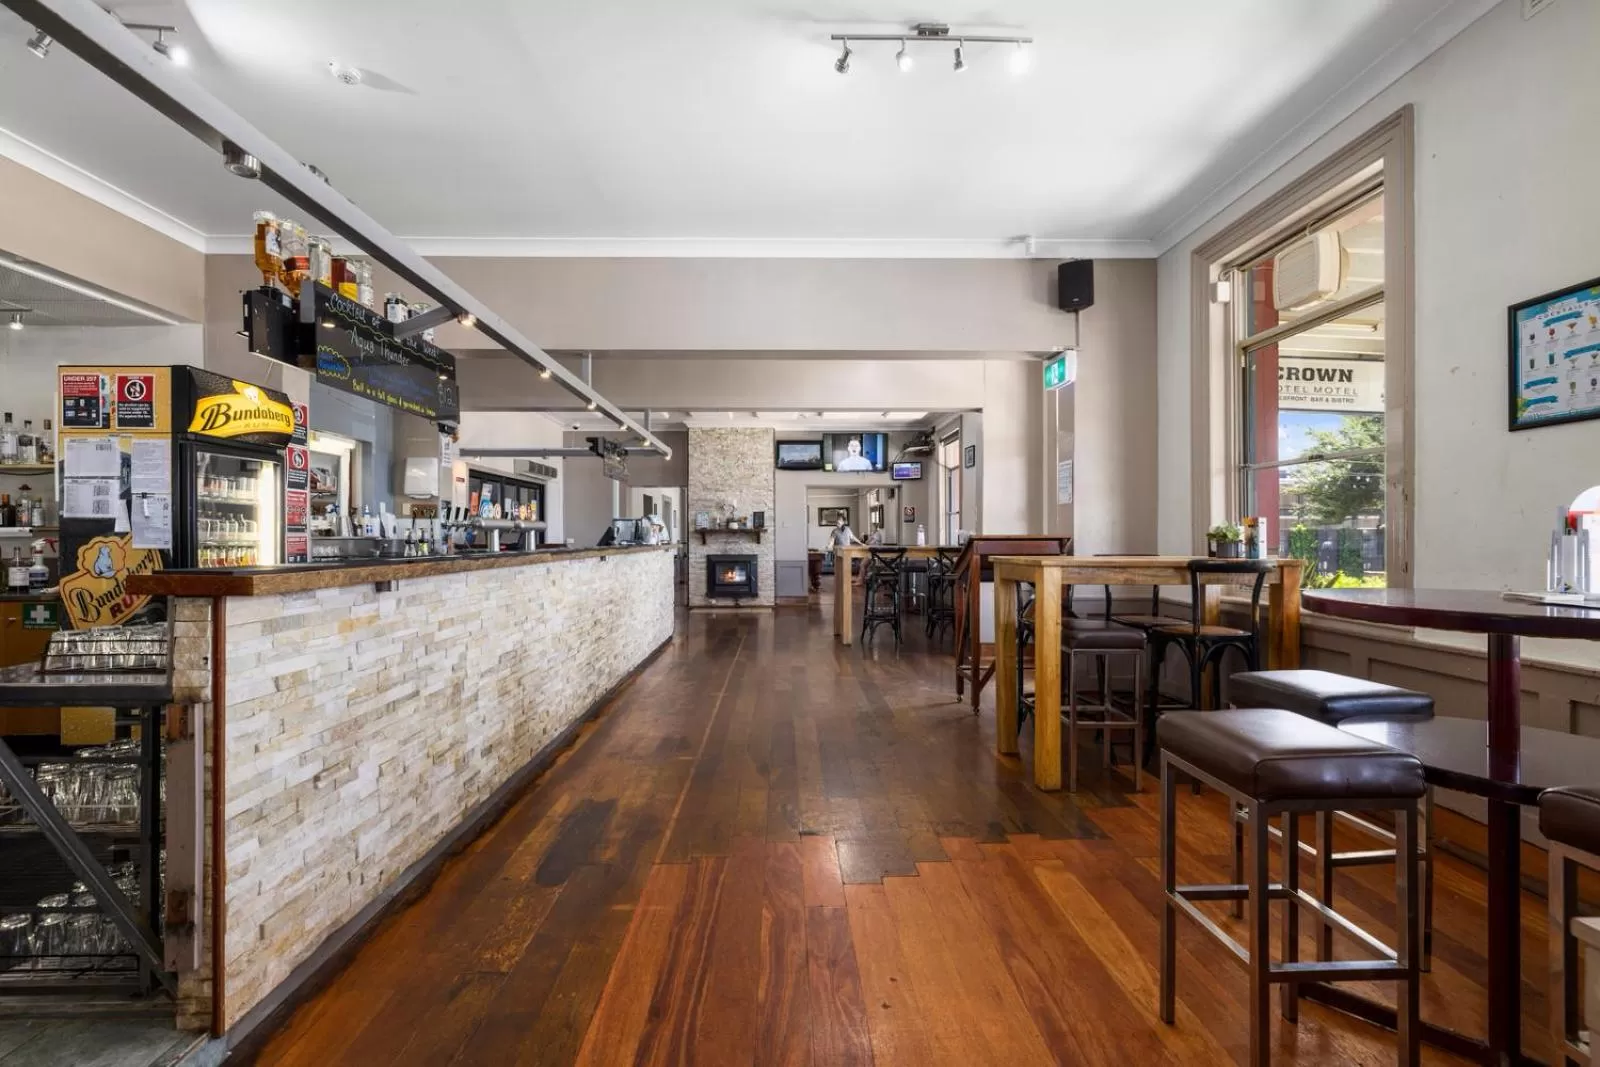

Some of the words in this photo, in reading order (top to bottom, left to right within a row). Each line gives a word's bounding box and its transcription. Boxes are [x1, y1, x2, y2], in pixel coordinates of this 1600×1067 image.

[1279, 385, 1309, 394] TEL
[1313, 385, 1359, 396] MOTEL
[200, 402, 291, 431] Bundaberg
[109, 594, 140, 619] RU
